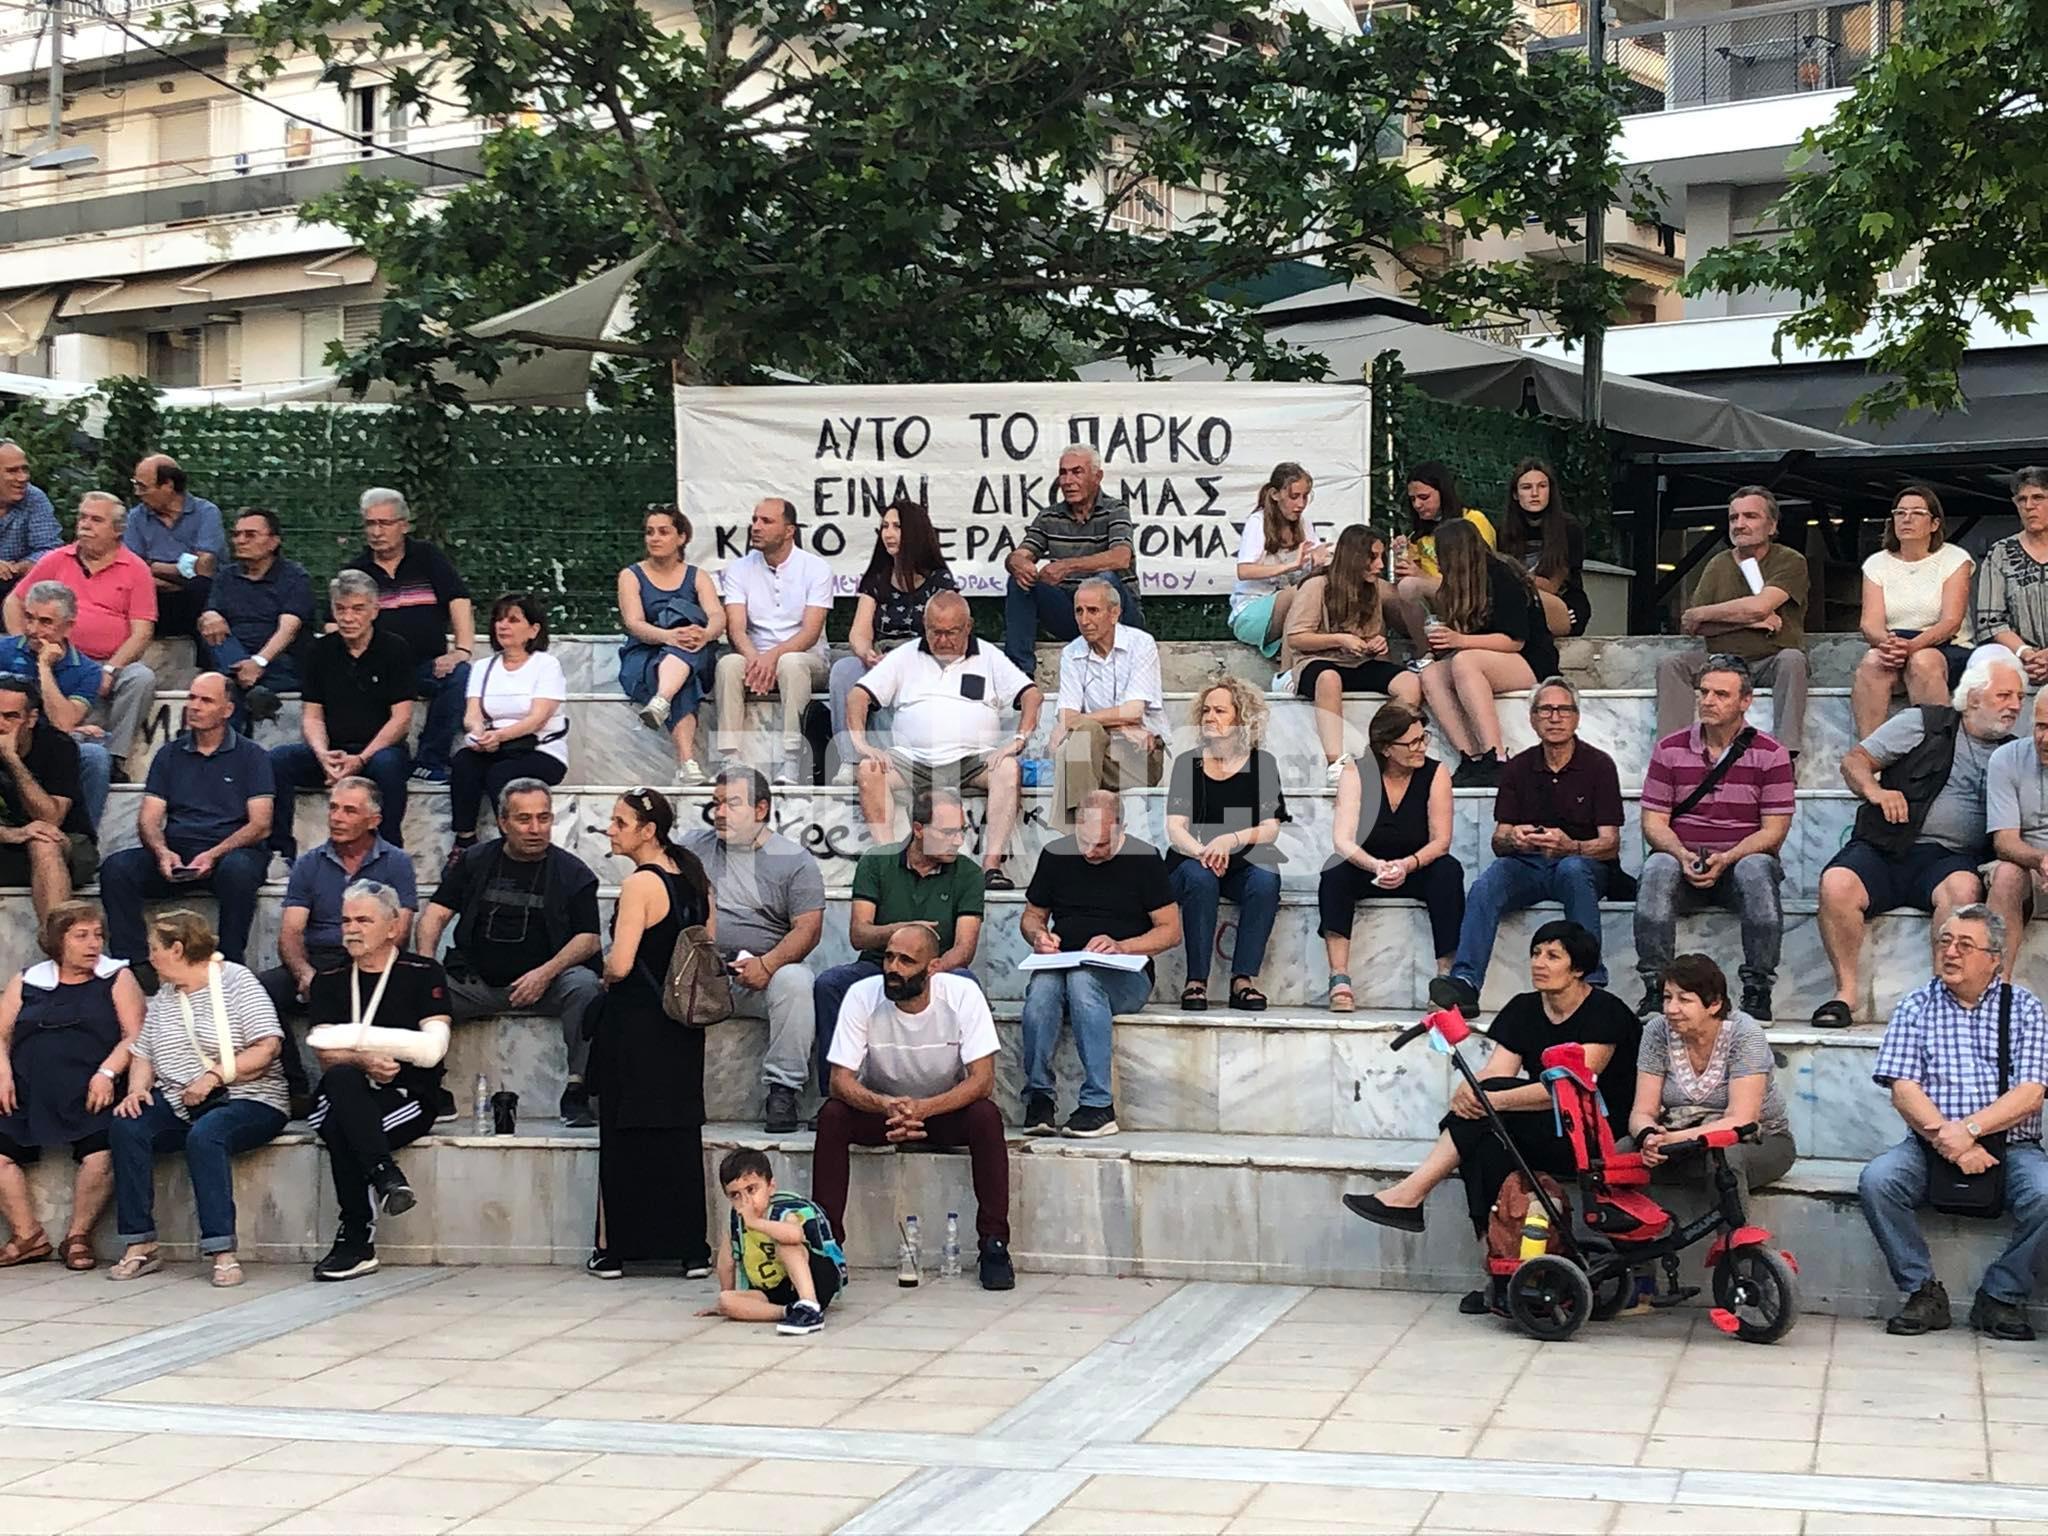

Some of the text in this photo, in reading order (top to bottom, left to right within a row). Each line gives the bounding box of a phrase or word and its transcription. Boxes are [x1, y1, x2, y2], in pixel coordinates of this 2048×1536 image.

[814, 412, 1232, 466] ΑΥΤΟ ΤΟ ΠΑΡΚΟ
[814, 472, 1237, 517] ΕΙΝΑΙ ΔΙΚ ΜΑΣ
